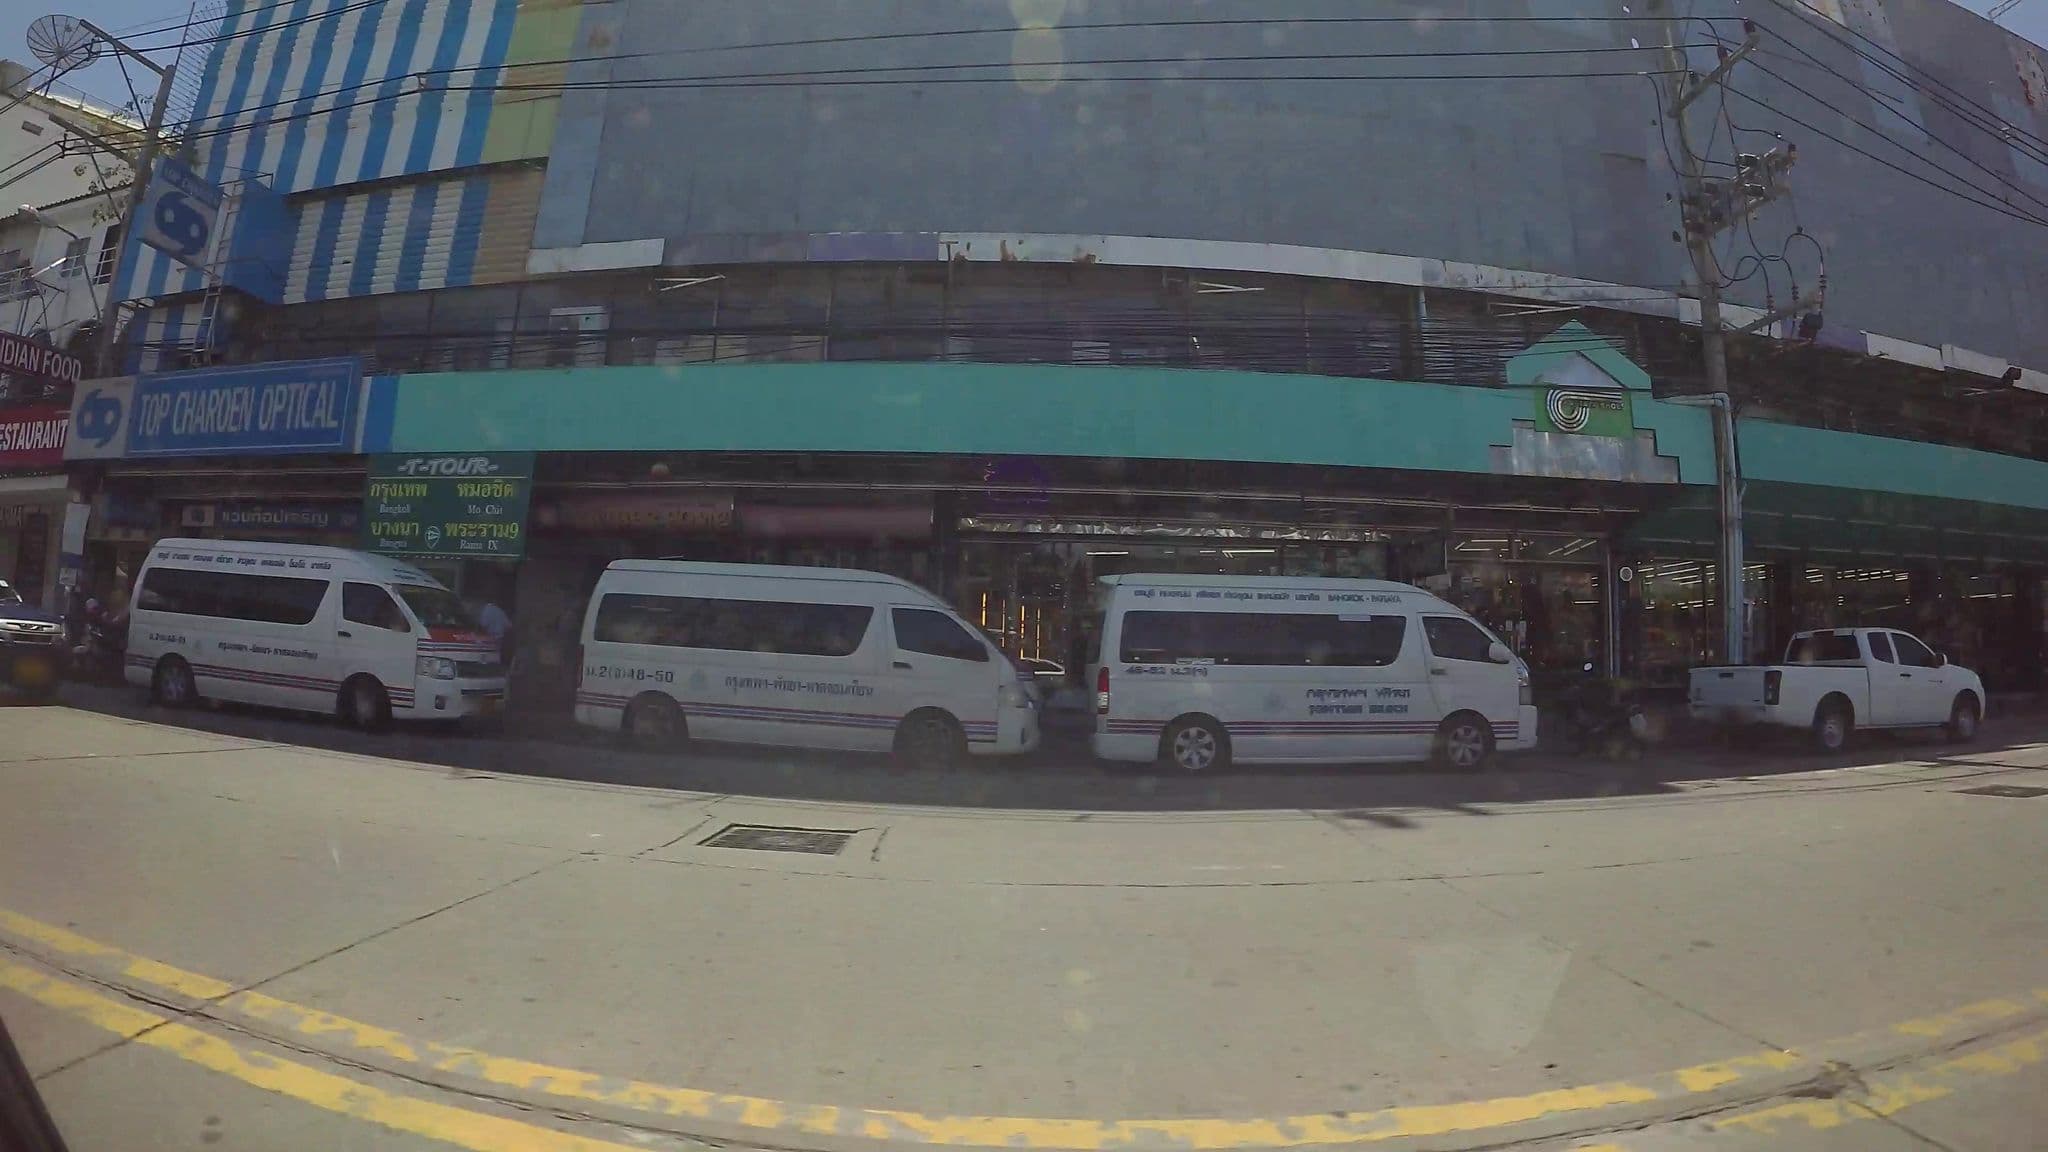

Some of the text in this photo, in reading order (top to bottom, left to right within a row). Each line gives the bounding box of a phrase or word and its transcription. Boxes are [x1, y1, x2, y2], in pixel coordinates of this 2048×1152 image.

[42, 350, 81, 384] FOOD
[138, 380, 339, 437] TOP CHAROEN OPTICAL
[370, 479, 513, 504] กรุงเทพ หมอชิต
[467, 505, 481, 514] Mo
[371, 521, 419, 536] บางนา
